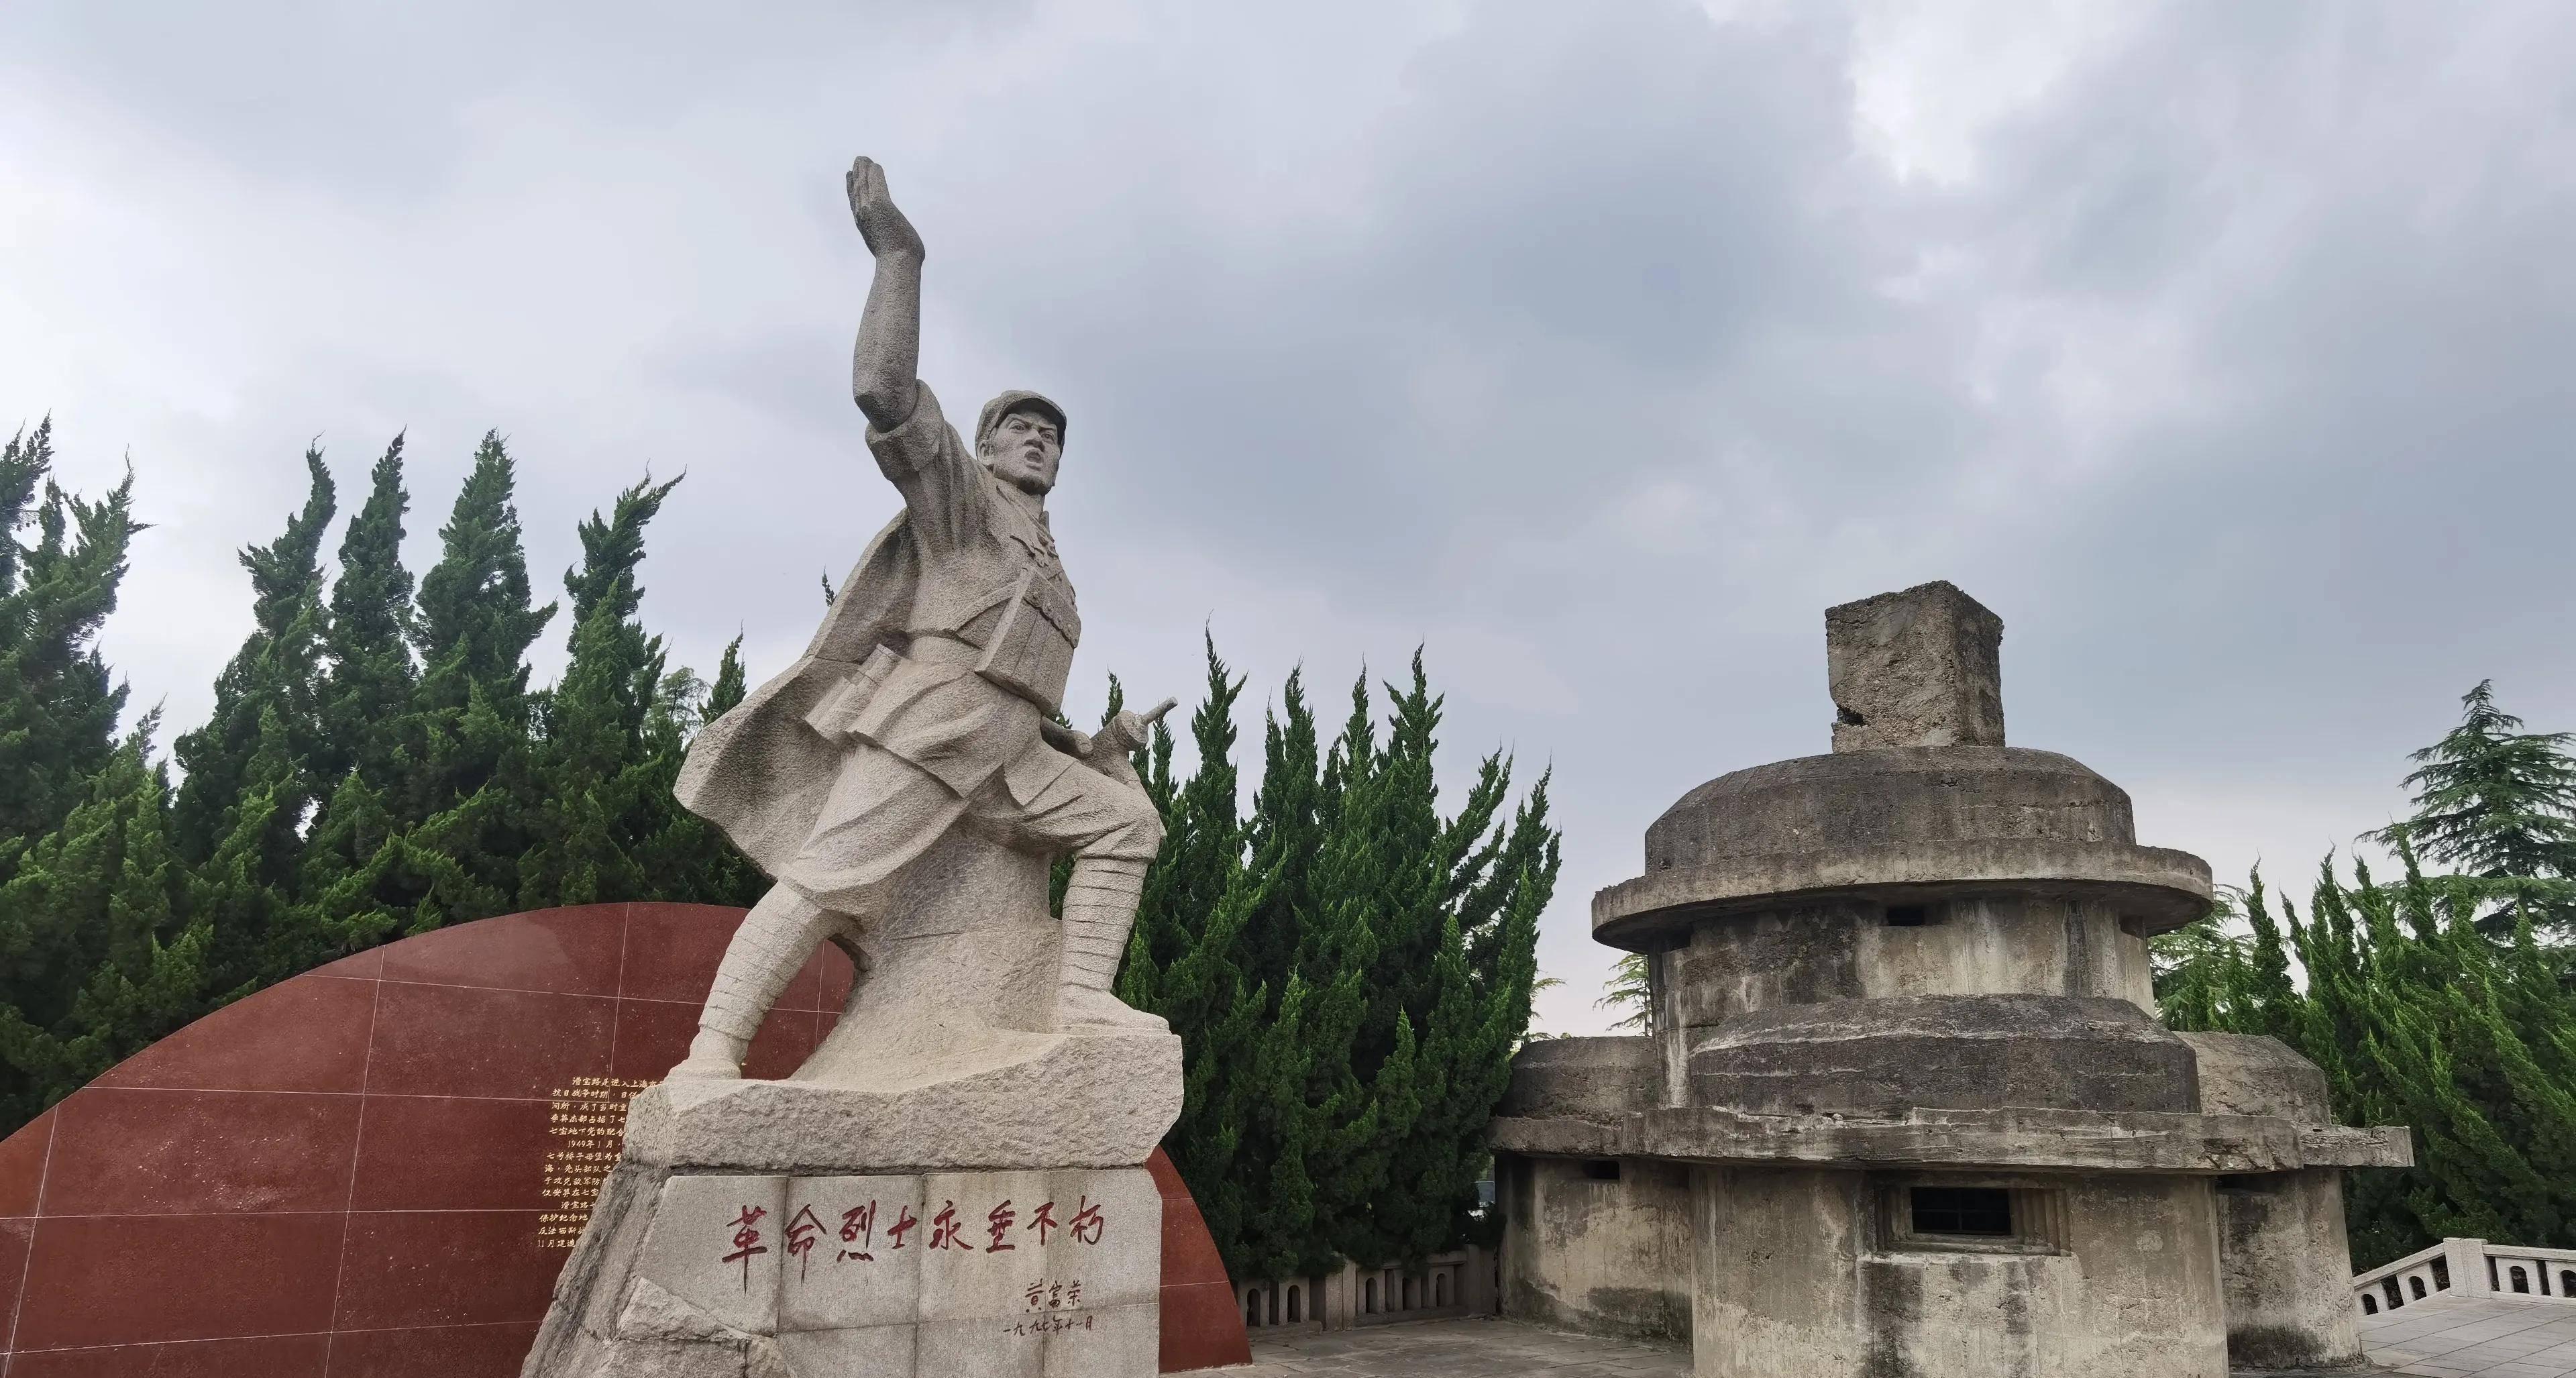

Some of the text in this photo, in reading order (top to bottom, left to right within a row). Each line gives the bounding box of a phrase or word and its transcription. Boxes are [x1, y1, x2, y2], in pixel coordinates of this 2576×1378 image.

[539, 1213, 588, 1222] 保护纪念地
[722, 1196, 1104, 1295] 革命烈士永垂不朽
